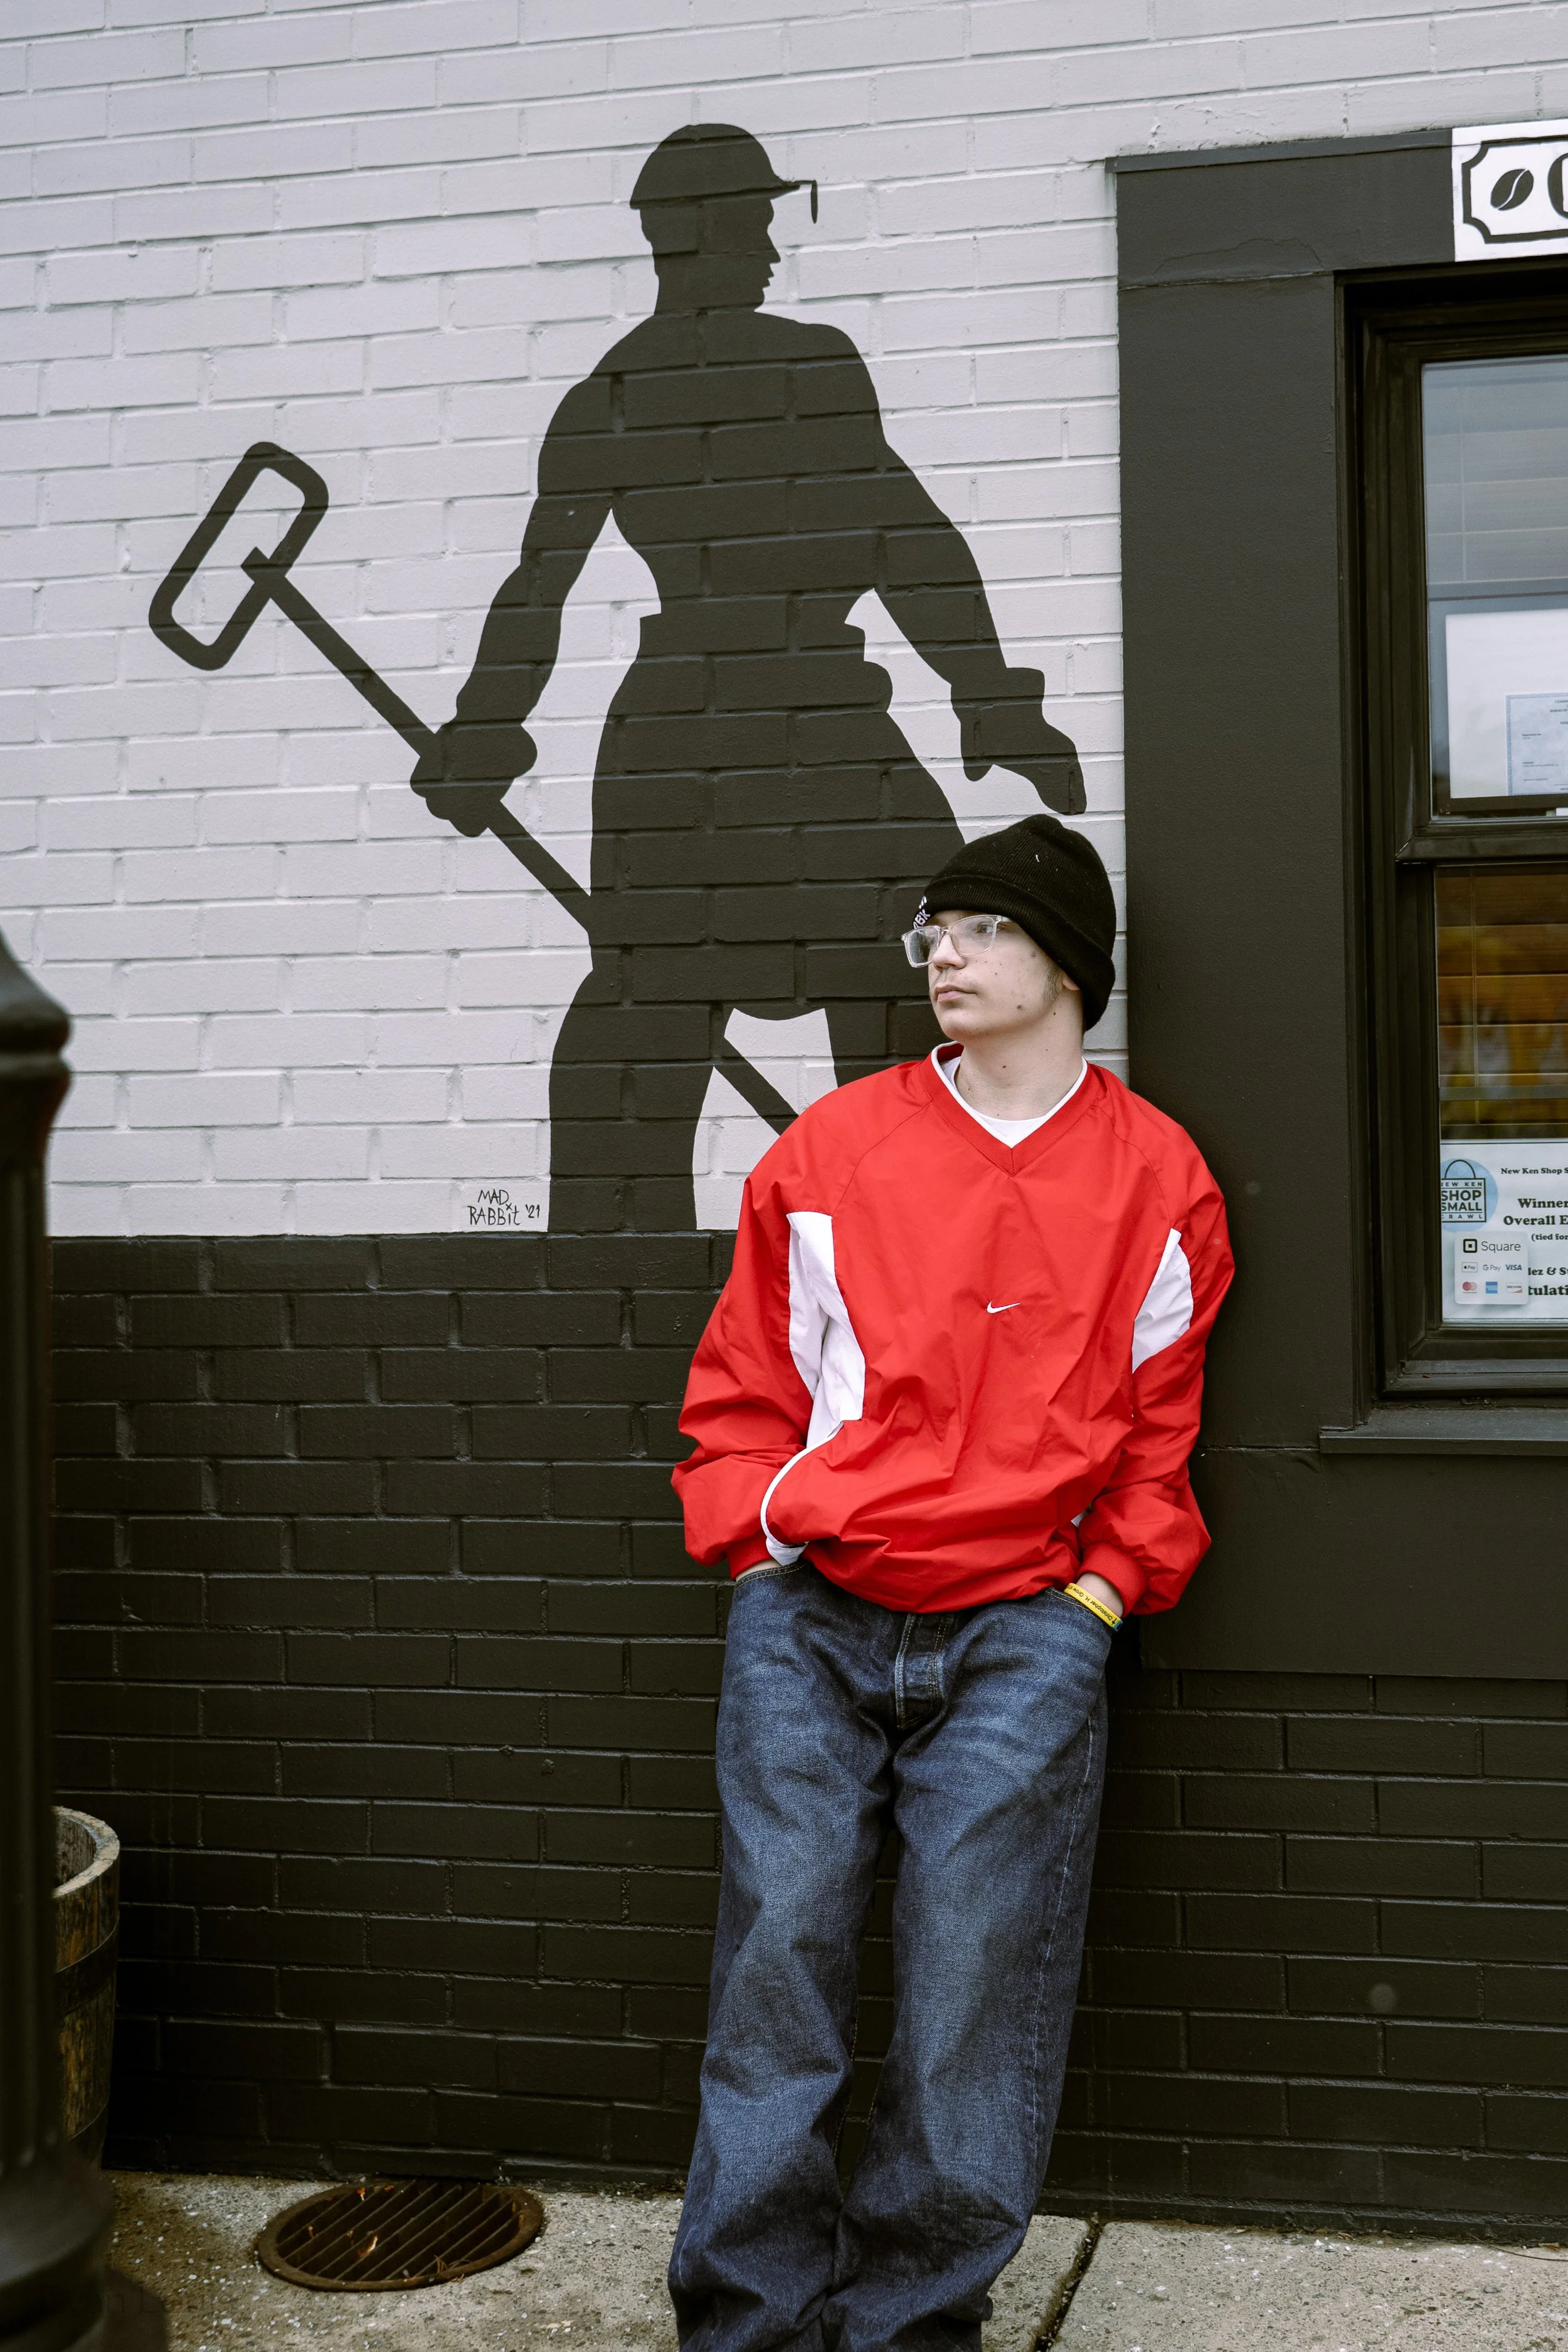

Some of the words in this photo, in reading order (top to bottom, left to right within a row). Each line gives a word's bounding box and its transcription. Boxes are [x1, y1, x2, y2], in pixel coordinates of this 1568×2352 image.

[477, 1189, 509, 1205] MAD
[1441, 1190, 1481, 1201] SHOP
[1441, 1202, 1482, 1211] SMALL
[1503, 1216, 1555, 1225] Overall
[1531, 1233, 1553, 1241] (tied
[1481, 1241, 1521, 1253] Square
[1547, 1267, 1556, 1275] &
[1073, 1587, 1084, 1597] Grow
[1090, 1601, 1113, 1621] Christopher
